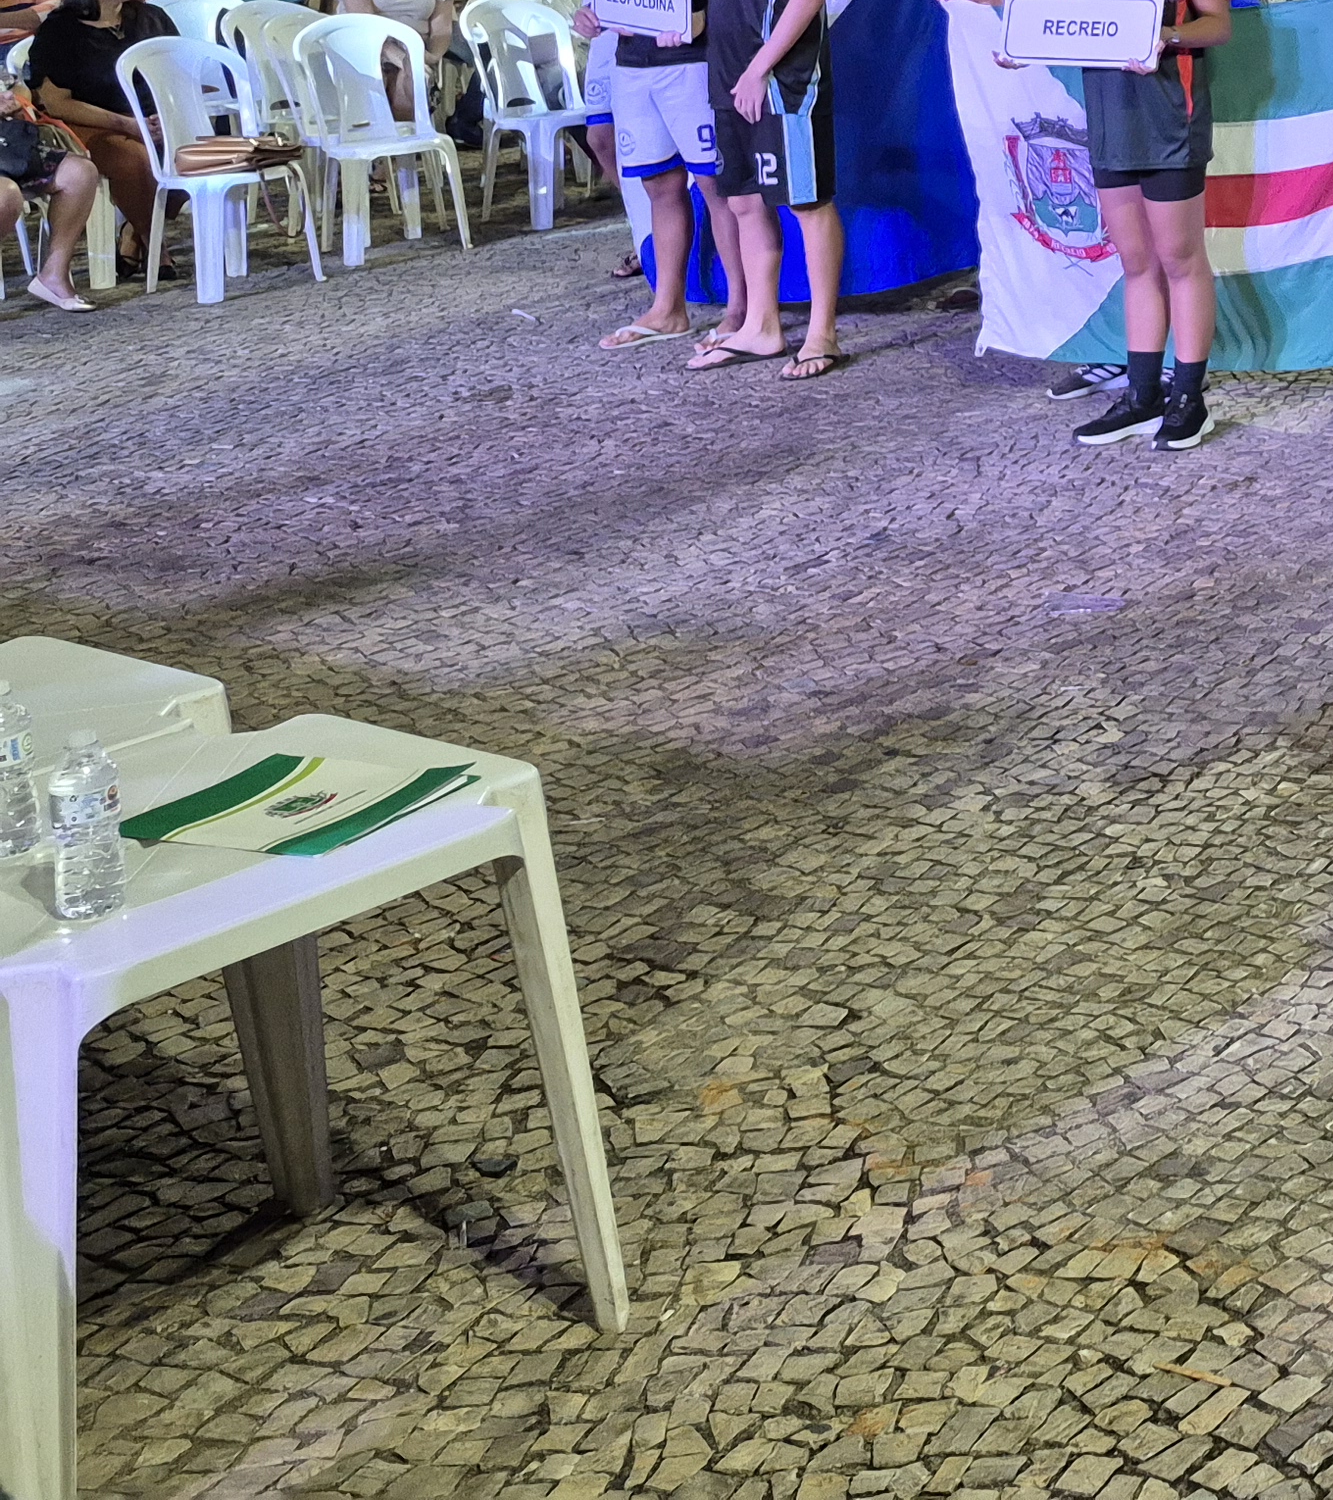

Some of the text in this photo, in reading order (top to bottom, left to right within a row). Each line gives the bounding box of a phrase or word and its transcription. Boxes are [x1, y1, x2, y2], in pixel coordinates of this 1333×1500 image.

[1043, 19, 1119, 37] RECREIO
[697, 123, 717, 151] 9
[755, 152, 778, 185] 12
